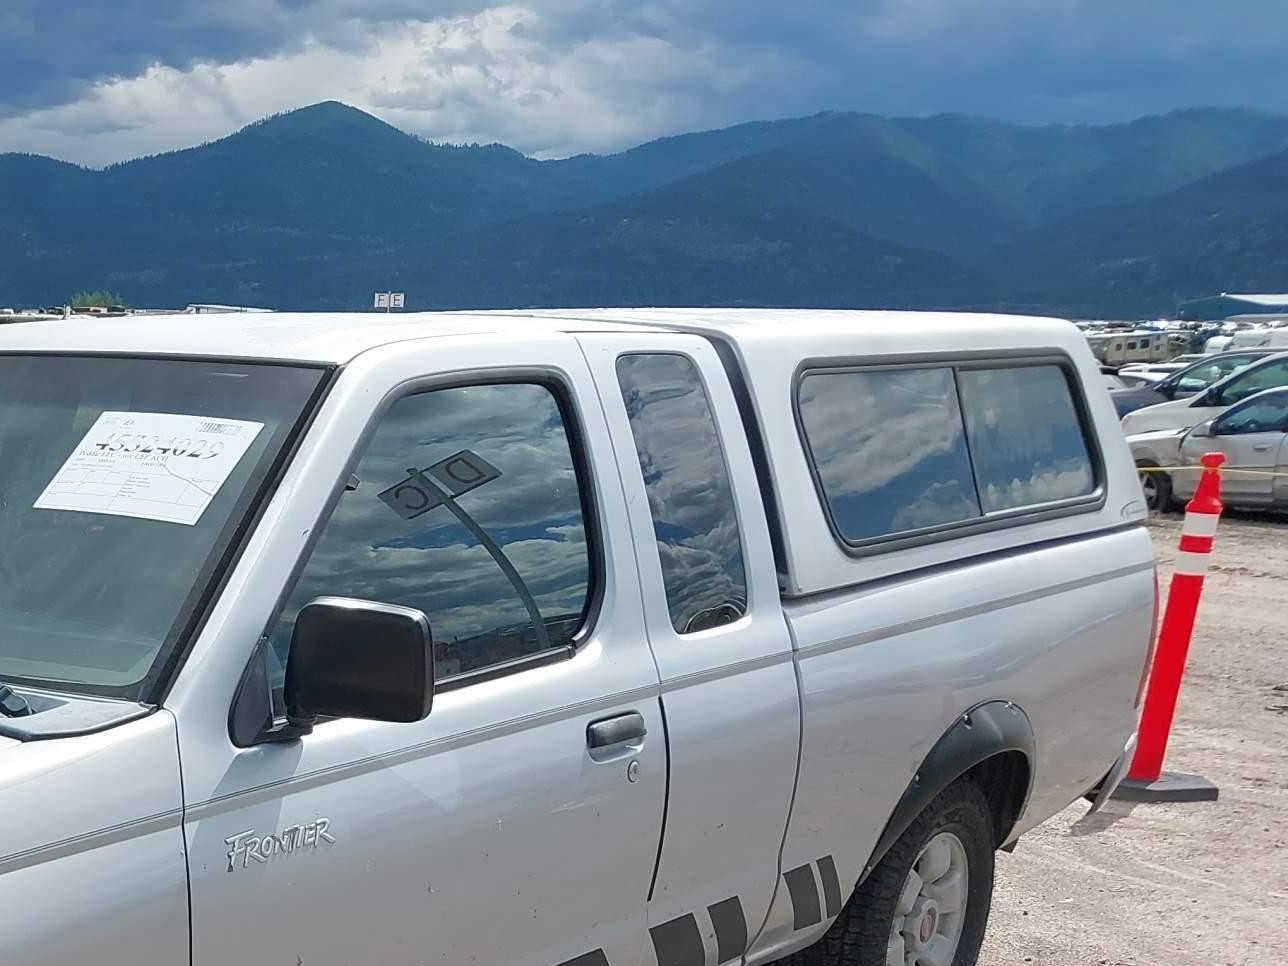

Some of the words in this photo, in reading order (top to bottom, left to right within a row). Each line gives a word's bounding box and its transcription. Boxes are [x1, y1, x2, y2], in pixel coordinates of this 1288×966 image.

[378, 294, 385, 306] F
[393, 294, 401, 306] E
[95, 432, 226, 460] 45524029
[224, 817, 336, 873] FRONTIER
